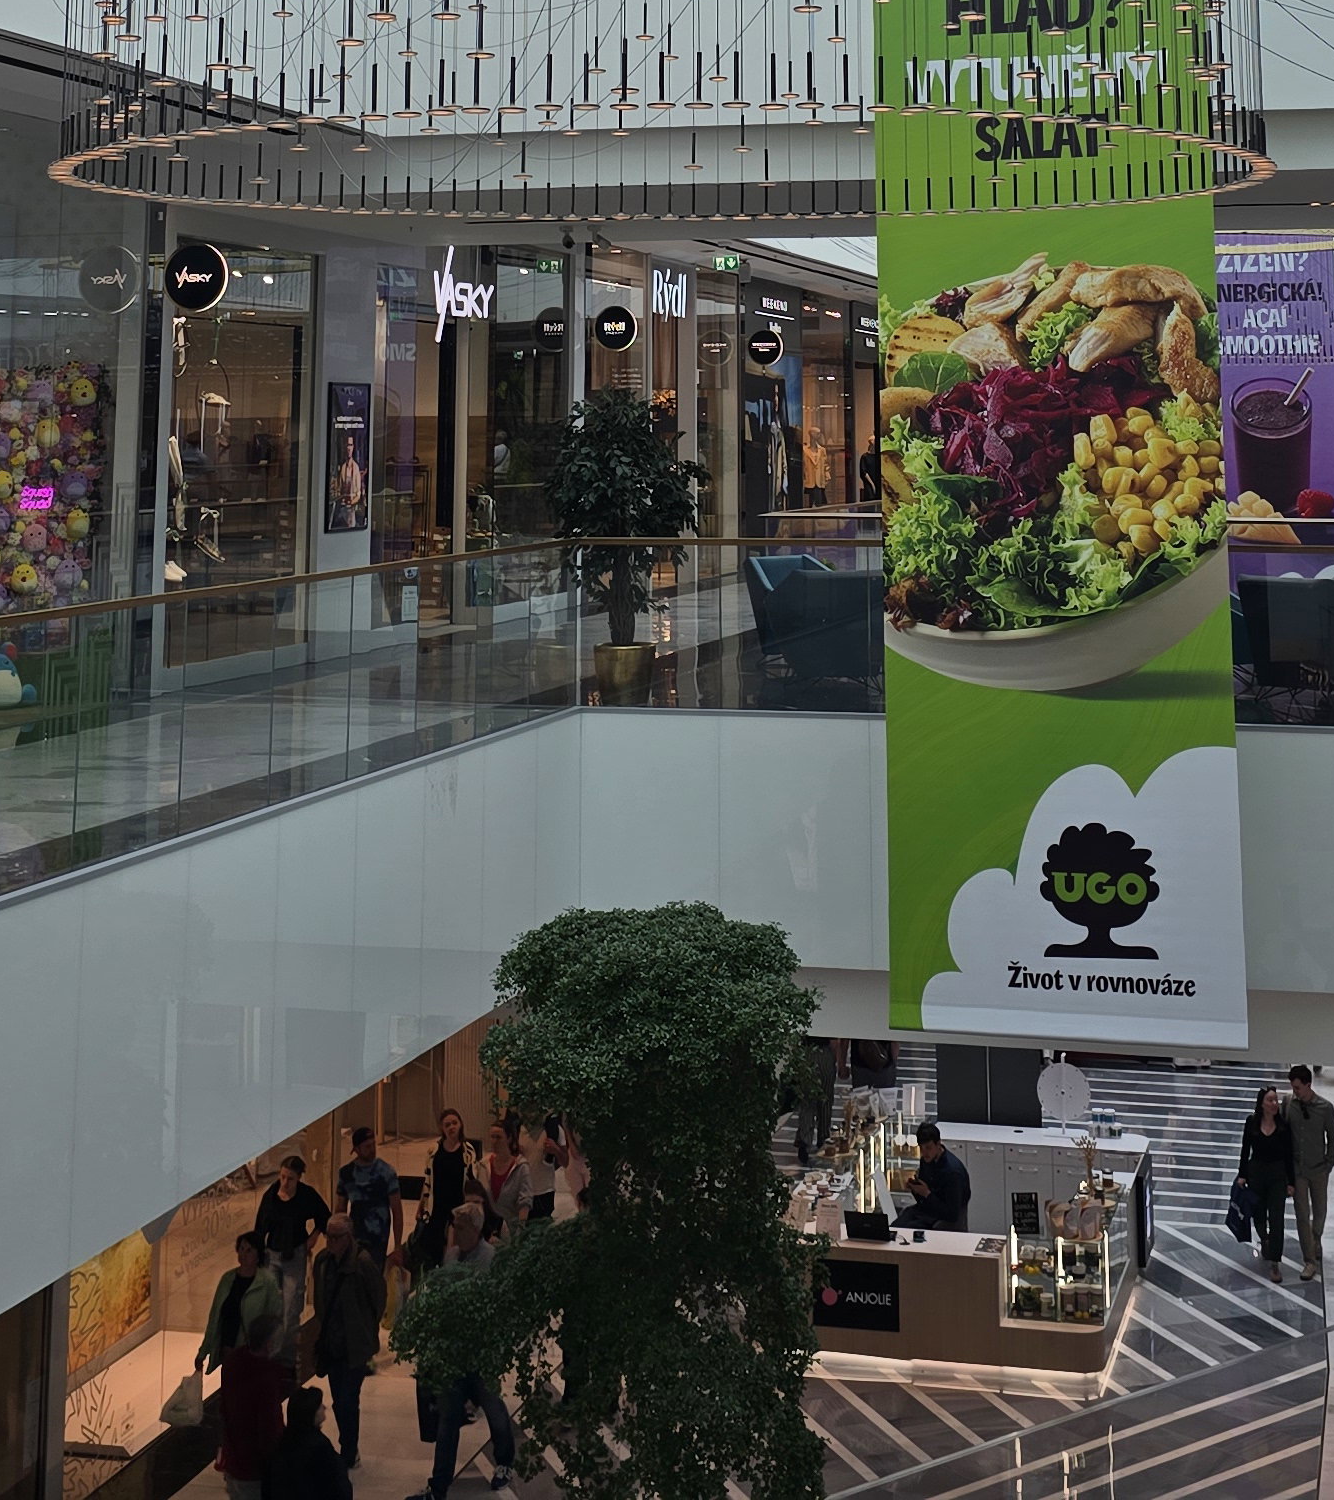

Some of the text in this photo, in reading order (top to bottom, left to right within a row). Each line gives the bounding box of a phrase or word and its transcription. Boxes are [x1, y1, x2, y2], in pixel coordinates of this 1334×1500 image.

[975, 105, 1107, 161] SALÁT
[175, 266, 212, 288] VASKY
[434, 245, 494, 342] VASKY
[652, 268, 687, 321] Rýdl
[1216, 278, 1323, 303] NERGICKÁ!
[1050, 869, 1149, 906] UGO
[1007, 960, 1197, 998] Život v rovnováze
[845, 1290, 892, 1307] ANJOLIE
